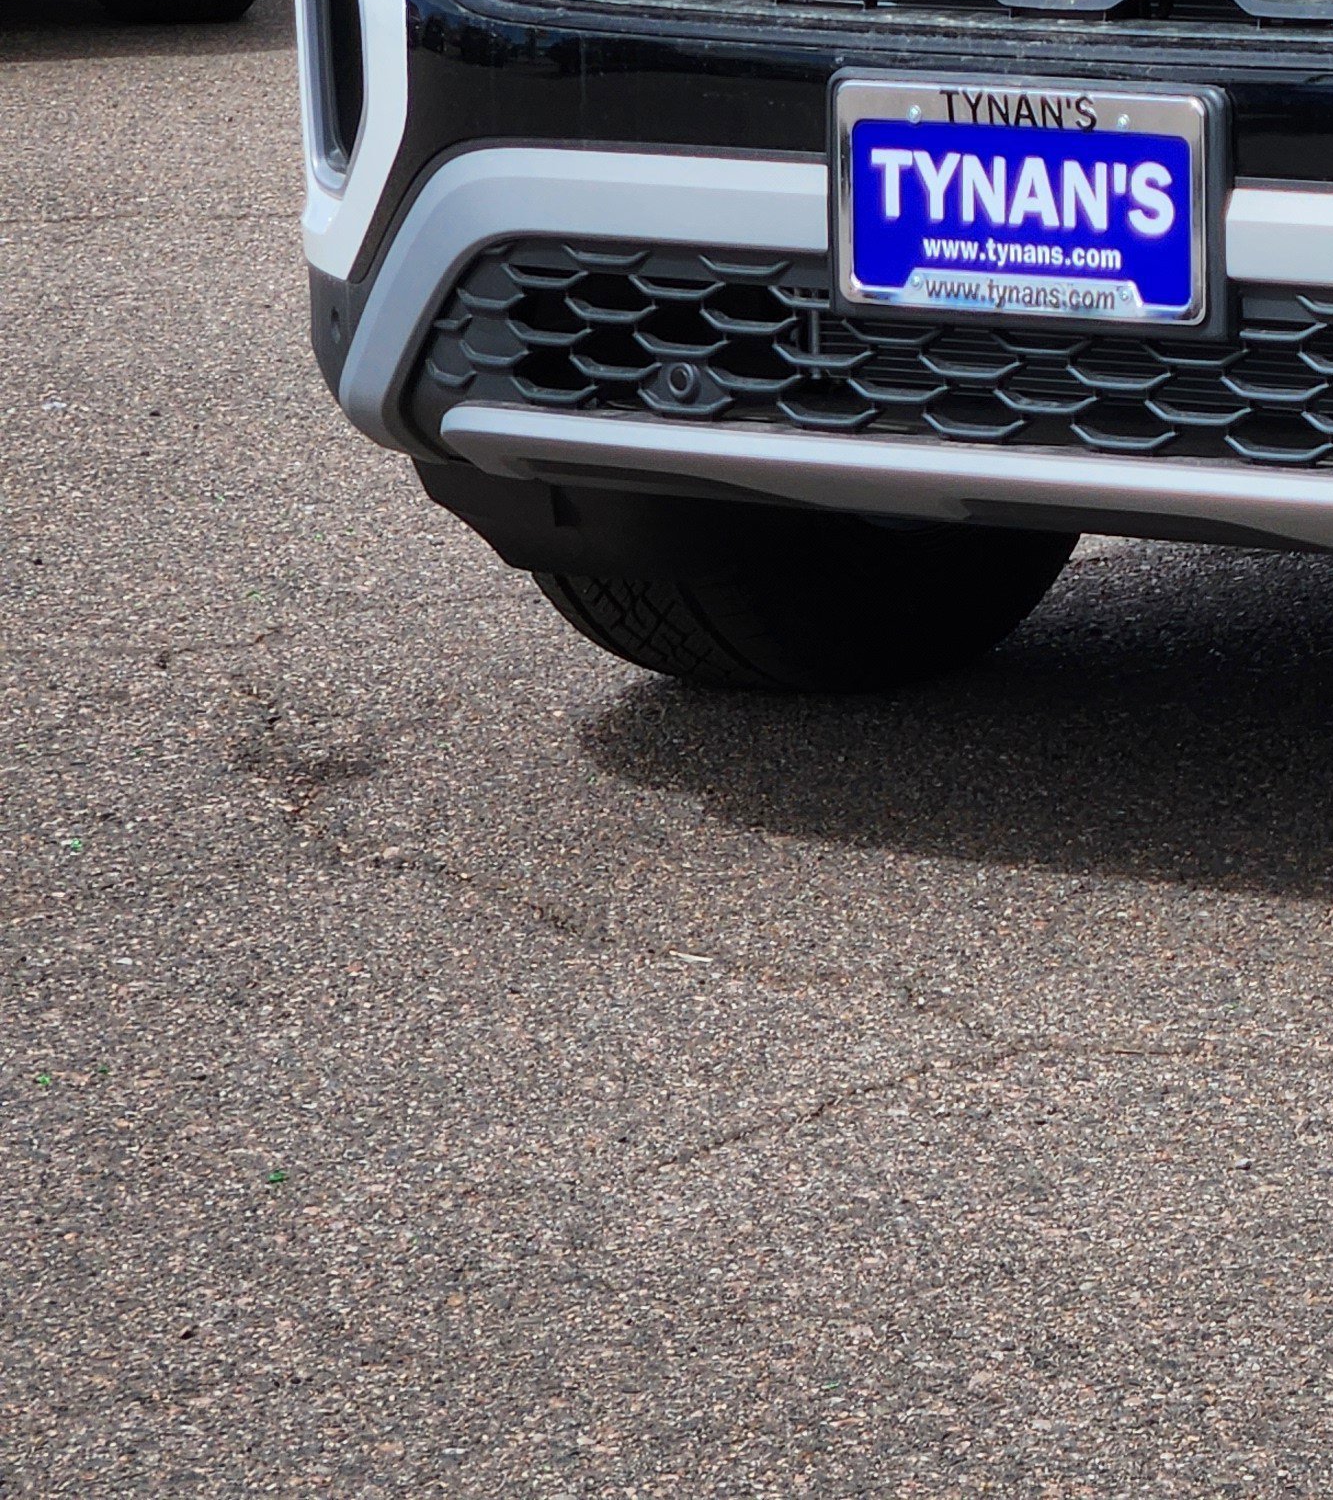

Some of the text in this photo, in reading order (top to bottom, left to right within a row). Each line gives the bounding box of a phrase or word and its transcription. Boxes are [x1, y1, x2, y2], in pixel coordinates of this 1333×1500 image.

[939, 88, 1098, 133] TYNAN'S
[870, 148, 1176, 235] TYNAN'S
[922, 236, 1122, 270] www.tynans.com
[924, 278, 1116, 311] www.tynans.com
